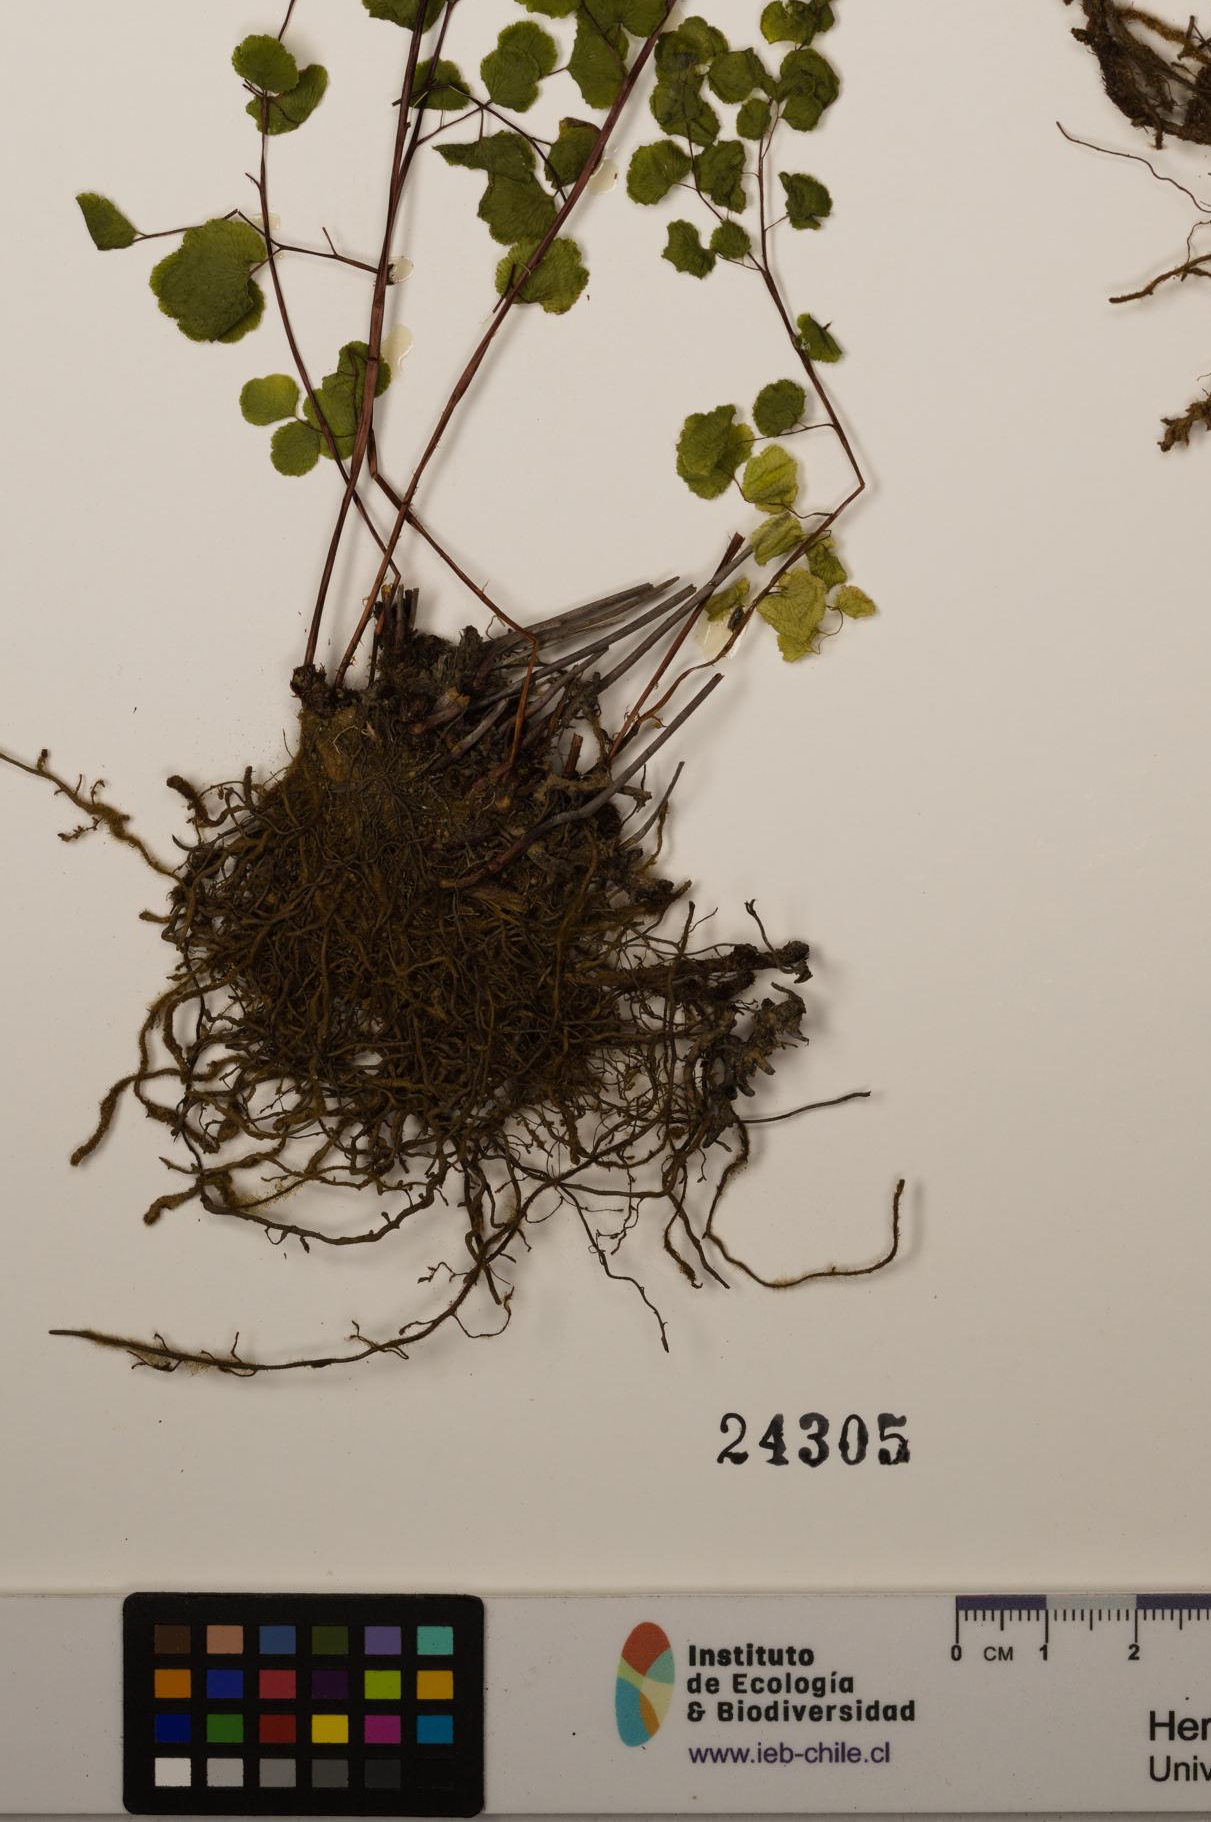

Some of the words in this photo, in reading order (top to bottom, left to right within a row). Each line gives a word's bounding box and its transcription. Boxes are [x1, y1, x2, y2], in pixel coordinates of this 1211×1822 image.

[717, 1413, 911, 1467] 24305
[688, 1643, 815, 1667] Instituto
[951, 1644, 963, 1661] 0
[983, 1646, 1014, 1661] CM
[1039, 1643, 1048, 1661] 1
[1128, 1643, 1141, 1660] 2
[687, 1672, 720, 1695] de
[733, 1671, 854, 1698] Ecología
[687, 1701, 706, 1723] &
[718, 1700, 916, 1723] Biodiversidad
[688, 1741, 891, 1764] www.ieb-chile.cl
